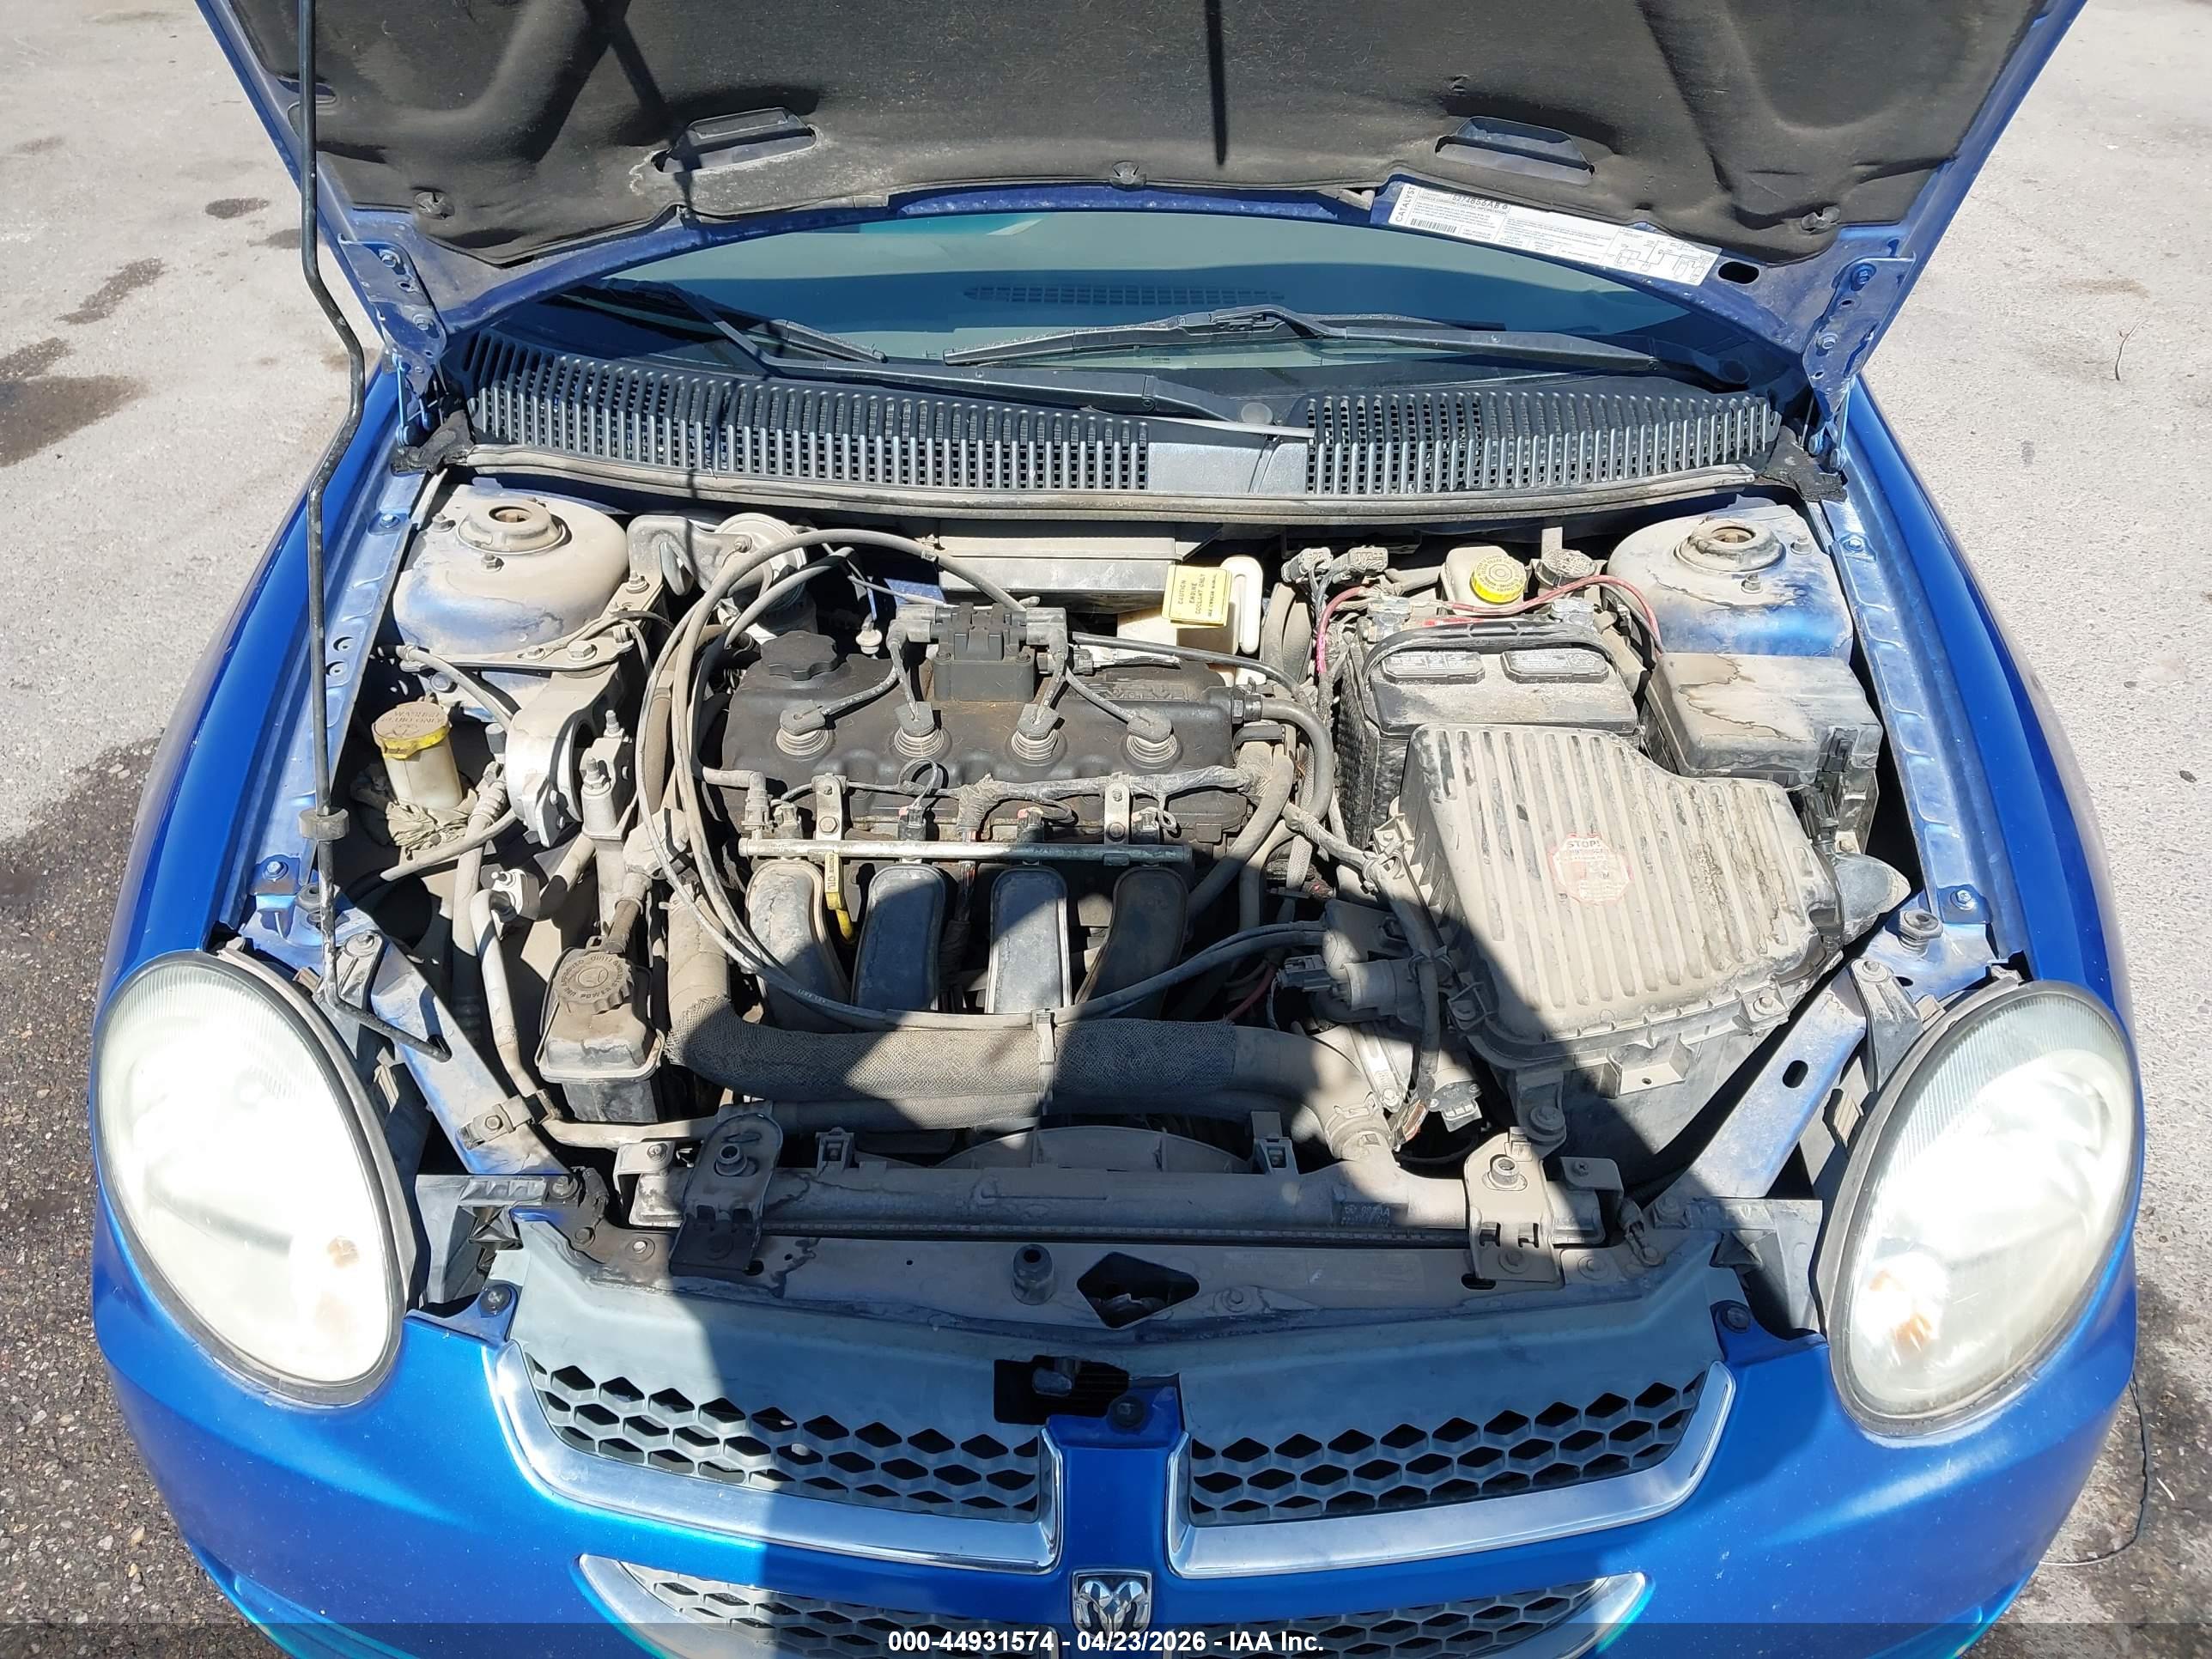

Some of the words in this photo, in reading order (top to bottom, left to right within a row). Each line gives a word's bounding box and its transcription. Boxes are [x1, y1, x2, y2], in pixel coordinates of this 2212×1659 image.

[1395, 186, 1416, 222] CATALYST
[1178, 580, 1187, 605] CAUTION
[1567, 840, 1601, 848] STOP!
